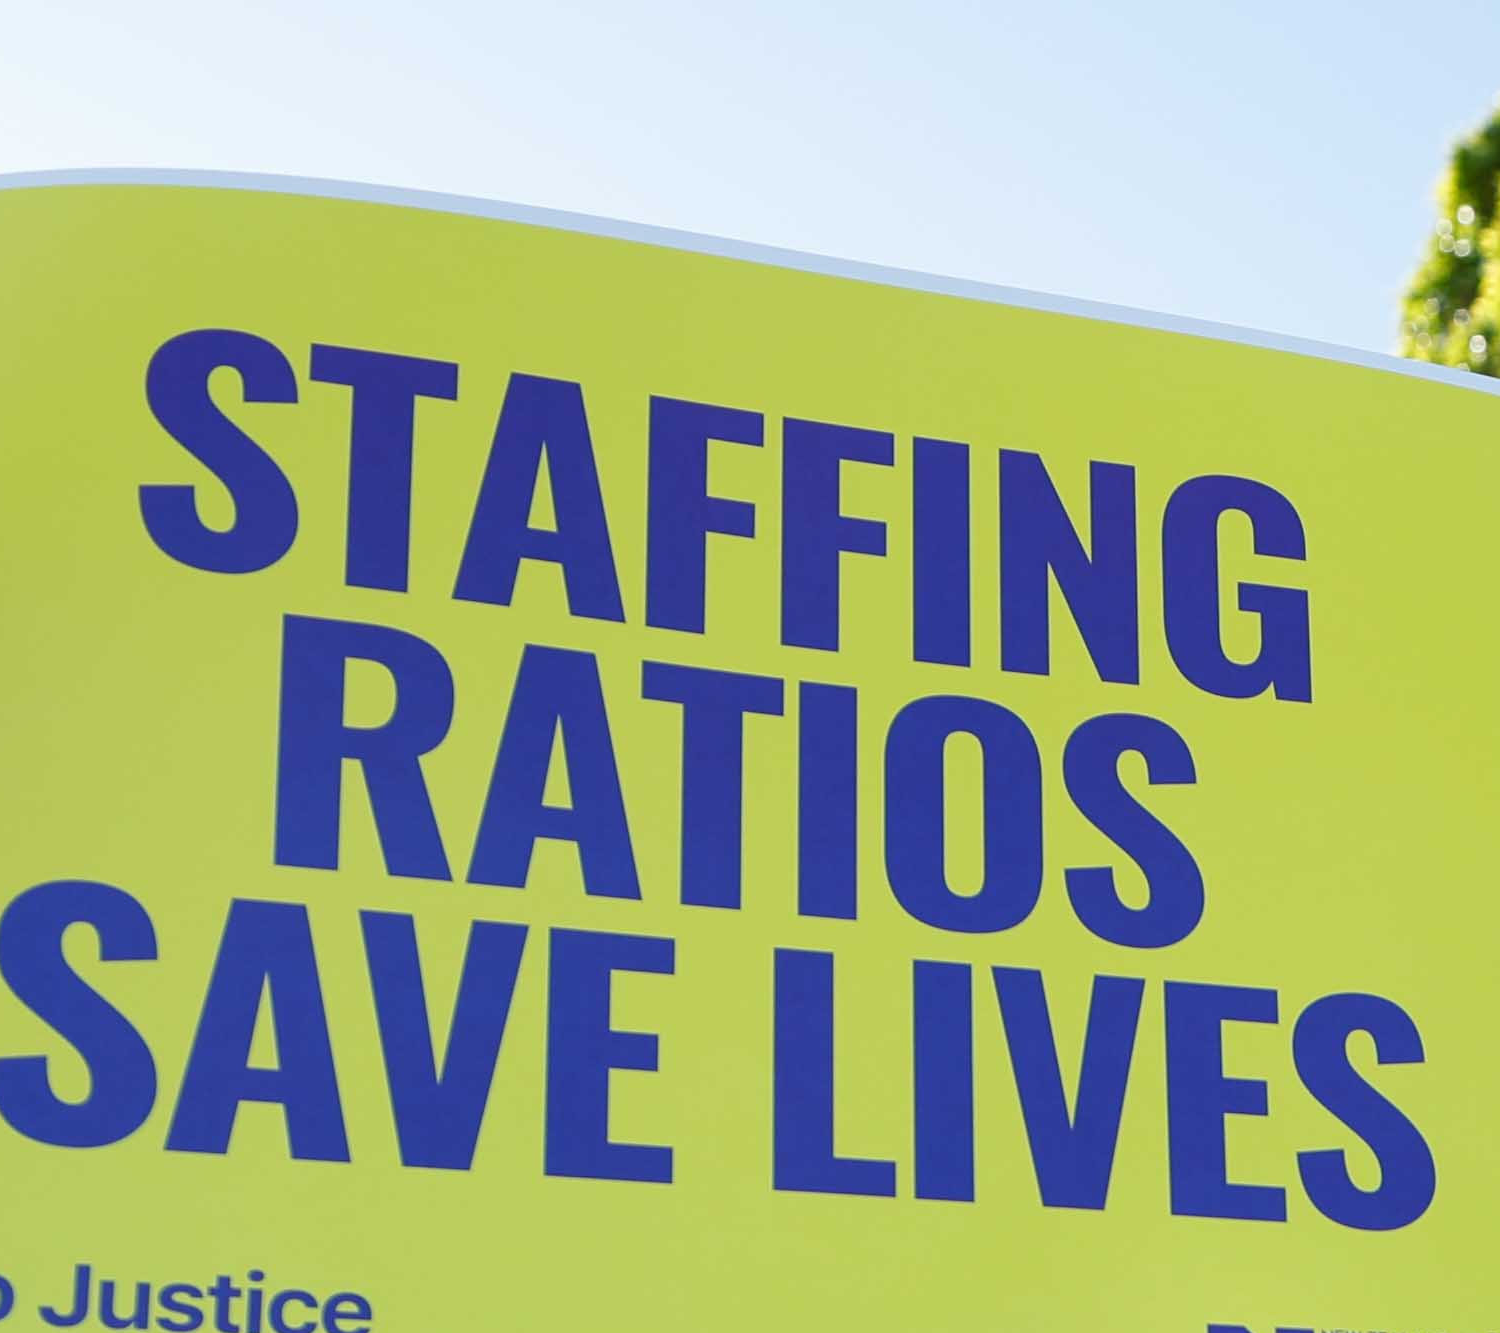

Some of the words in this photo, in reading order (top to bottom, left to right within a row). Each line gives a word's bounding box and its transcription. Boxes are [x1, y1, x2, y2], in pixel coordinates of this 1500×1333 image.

[137, 328, 1314, 703] STAFFING
[273, 614, 1205, 949] RATIOS
[771, 947, 1437, 1231] LIVES
